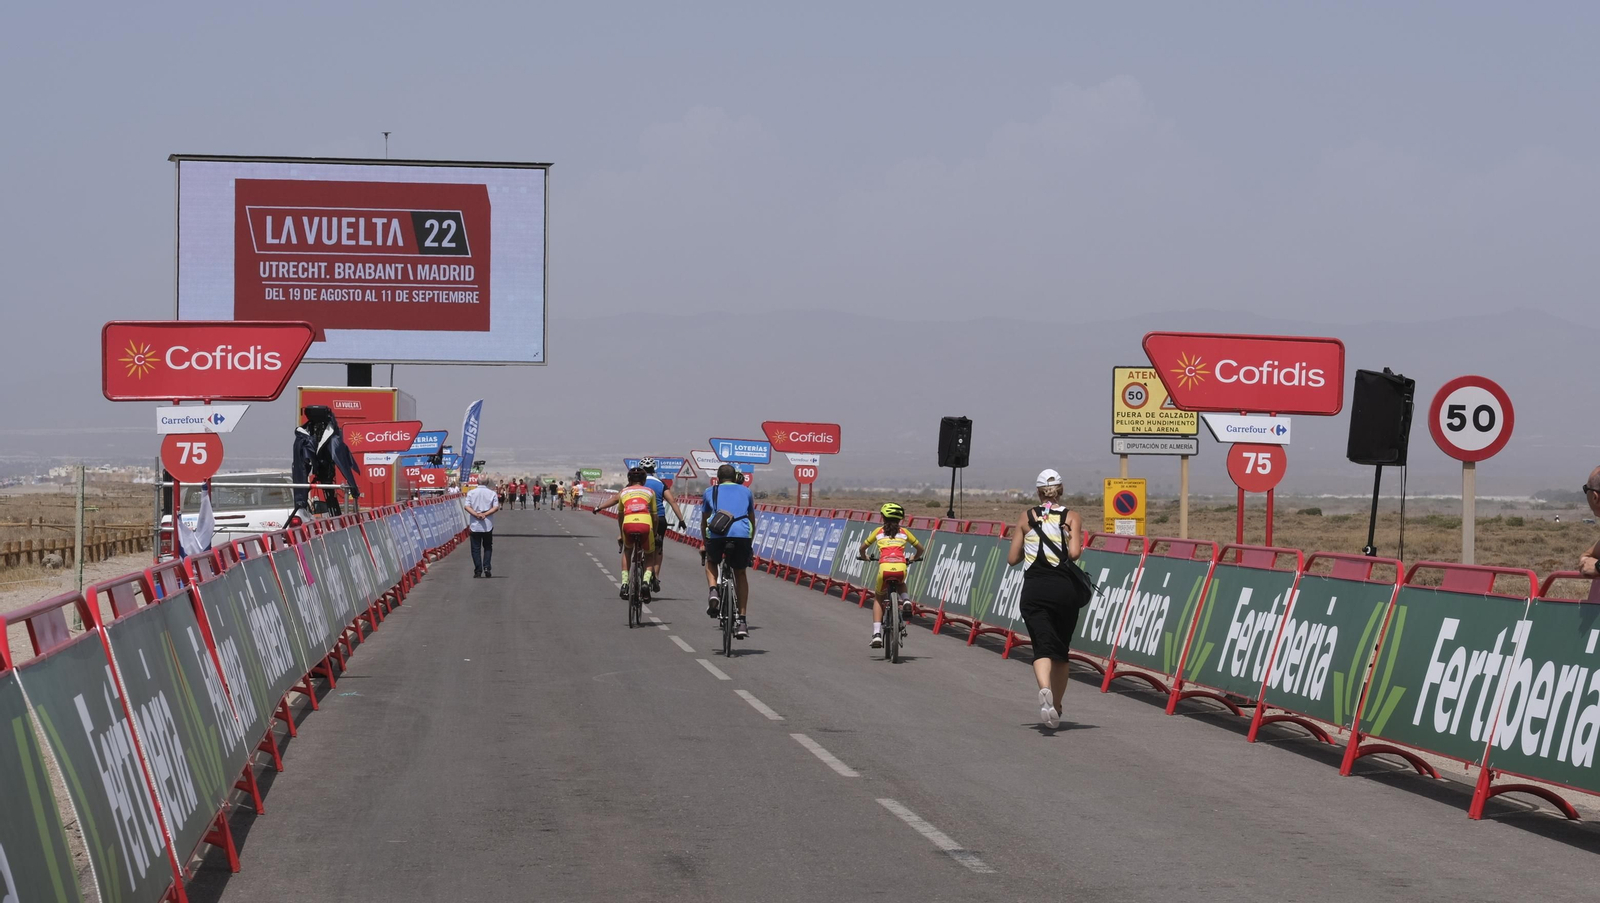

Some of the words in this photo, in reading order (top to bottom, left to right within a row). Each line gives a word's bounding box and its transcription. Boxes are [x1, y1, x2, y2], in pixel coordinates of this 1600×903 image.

[266, 215, 298, 244] LA
[302, 216, 404, 247] VUELTA
[424, 218, 457, 248] 22
[259, 261, 330, 279] UTRECHT.
[334, 262, 405, 280] BRABANT
[417, 264, 475, 282] MADRID
[265, 287, 286, 301] DEL
[288, 287, 301, 301] 19
[303, 288, 318, 301] DE
[320, 288, 362, 302] AGOSTO
[364, 289, 378, 302] AL
[381, 289, 392, 302] 11
[395, 290, 409, 302] DE
[412, 290, 480, 304] SEPTIEMBRE
[165, 344, 282, 371] Cofidis
[1127, 371, 1158, 380] ATEN
[1214, 359, 1326, 388] Cofidis
[1127, 391, 1143, 400] 50
[161, 415, 205, 425] Carrefour
[1446, 403, 1496, 433] 50
[365, 430, 411, 443] Cofidis
[789, 431, 834, 444] Cofidis
[1226, 424, 1267, 434] Carrefour
[176, 441, 208, 465] 75
[1126, 442, 1160, 450] DIPUTACIÓN
[697, 456, 720, 464] Carrefo
[1242, 452, 1272, 475] 75
[368, 467, 386, 477] 100
[406, 467, 420, 476] 125
[797, 468, 815, 478] 100
[926, 542, 977, 606] Fertiberia
[1080, 567, 1171, 656] Fertiberia
[1217, 587, 1338, 702] Fertiberia
[1412, 616, 1600, 769] Fertiberia
